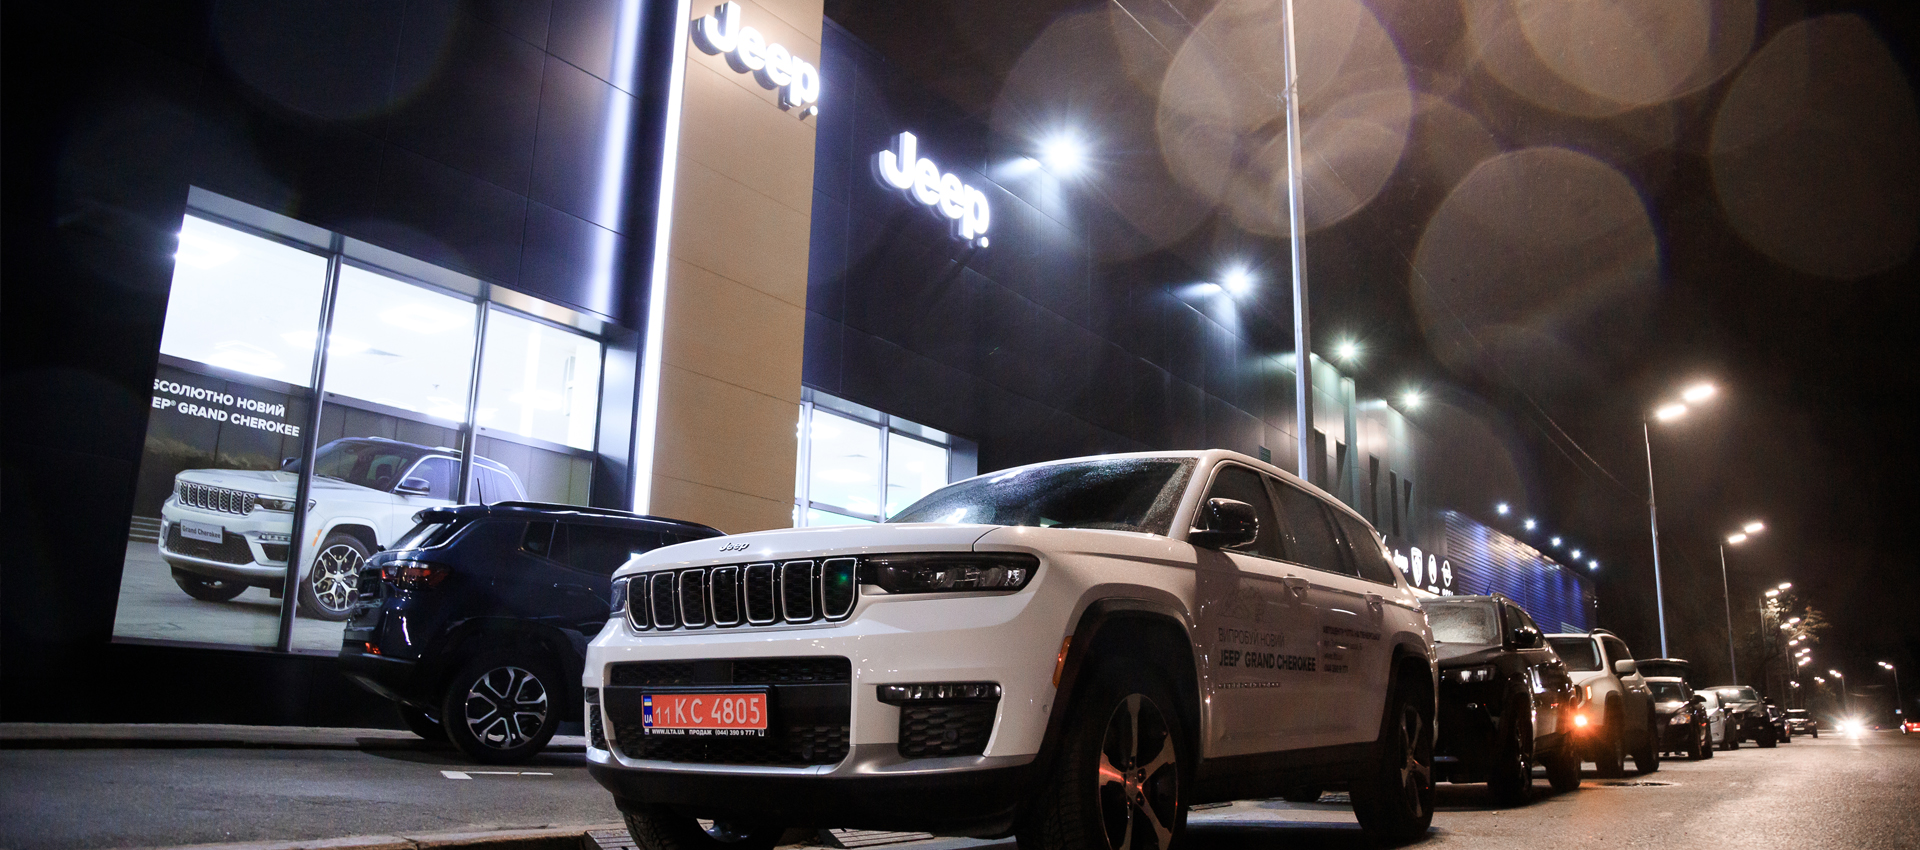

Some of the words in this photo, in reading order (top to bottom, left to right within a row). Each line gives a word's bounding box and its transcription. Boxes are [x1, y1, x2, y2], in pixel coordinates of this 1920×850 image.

[697, 0, 819, 112] Jeep
[878, 131, 990, 243] Jeep
[236, 397, 285, 417] НОВИЙ
[177, 402, 228, 422] GRAND
[230, 413, 300, 437] CHEROKEE
[182, 525, 197, 535] Grand
[197, 528, 221, 539] Cherokee
[718, 542, 750, 552] Jeep
[1218, 627, 1259, 646] ВИПРОБУЙ
[1260, 632, 1285, 648] НОВИЙ
[1245, 651, 1275, 669] GRAND
[1276, 654, 1316, 672] CHEROKEE
[644, 714, 653, 724] UA
[711, 698, 760, 724] 4805
